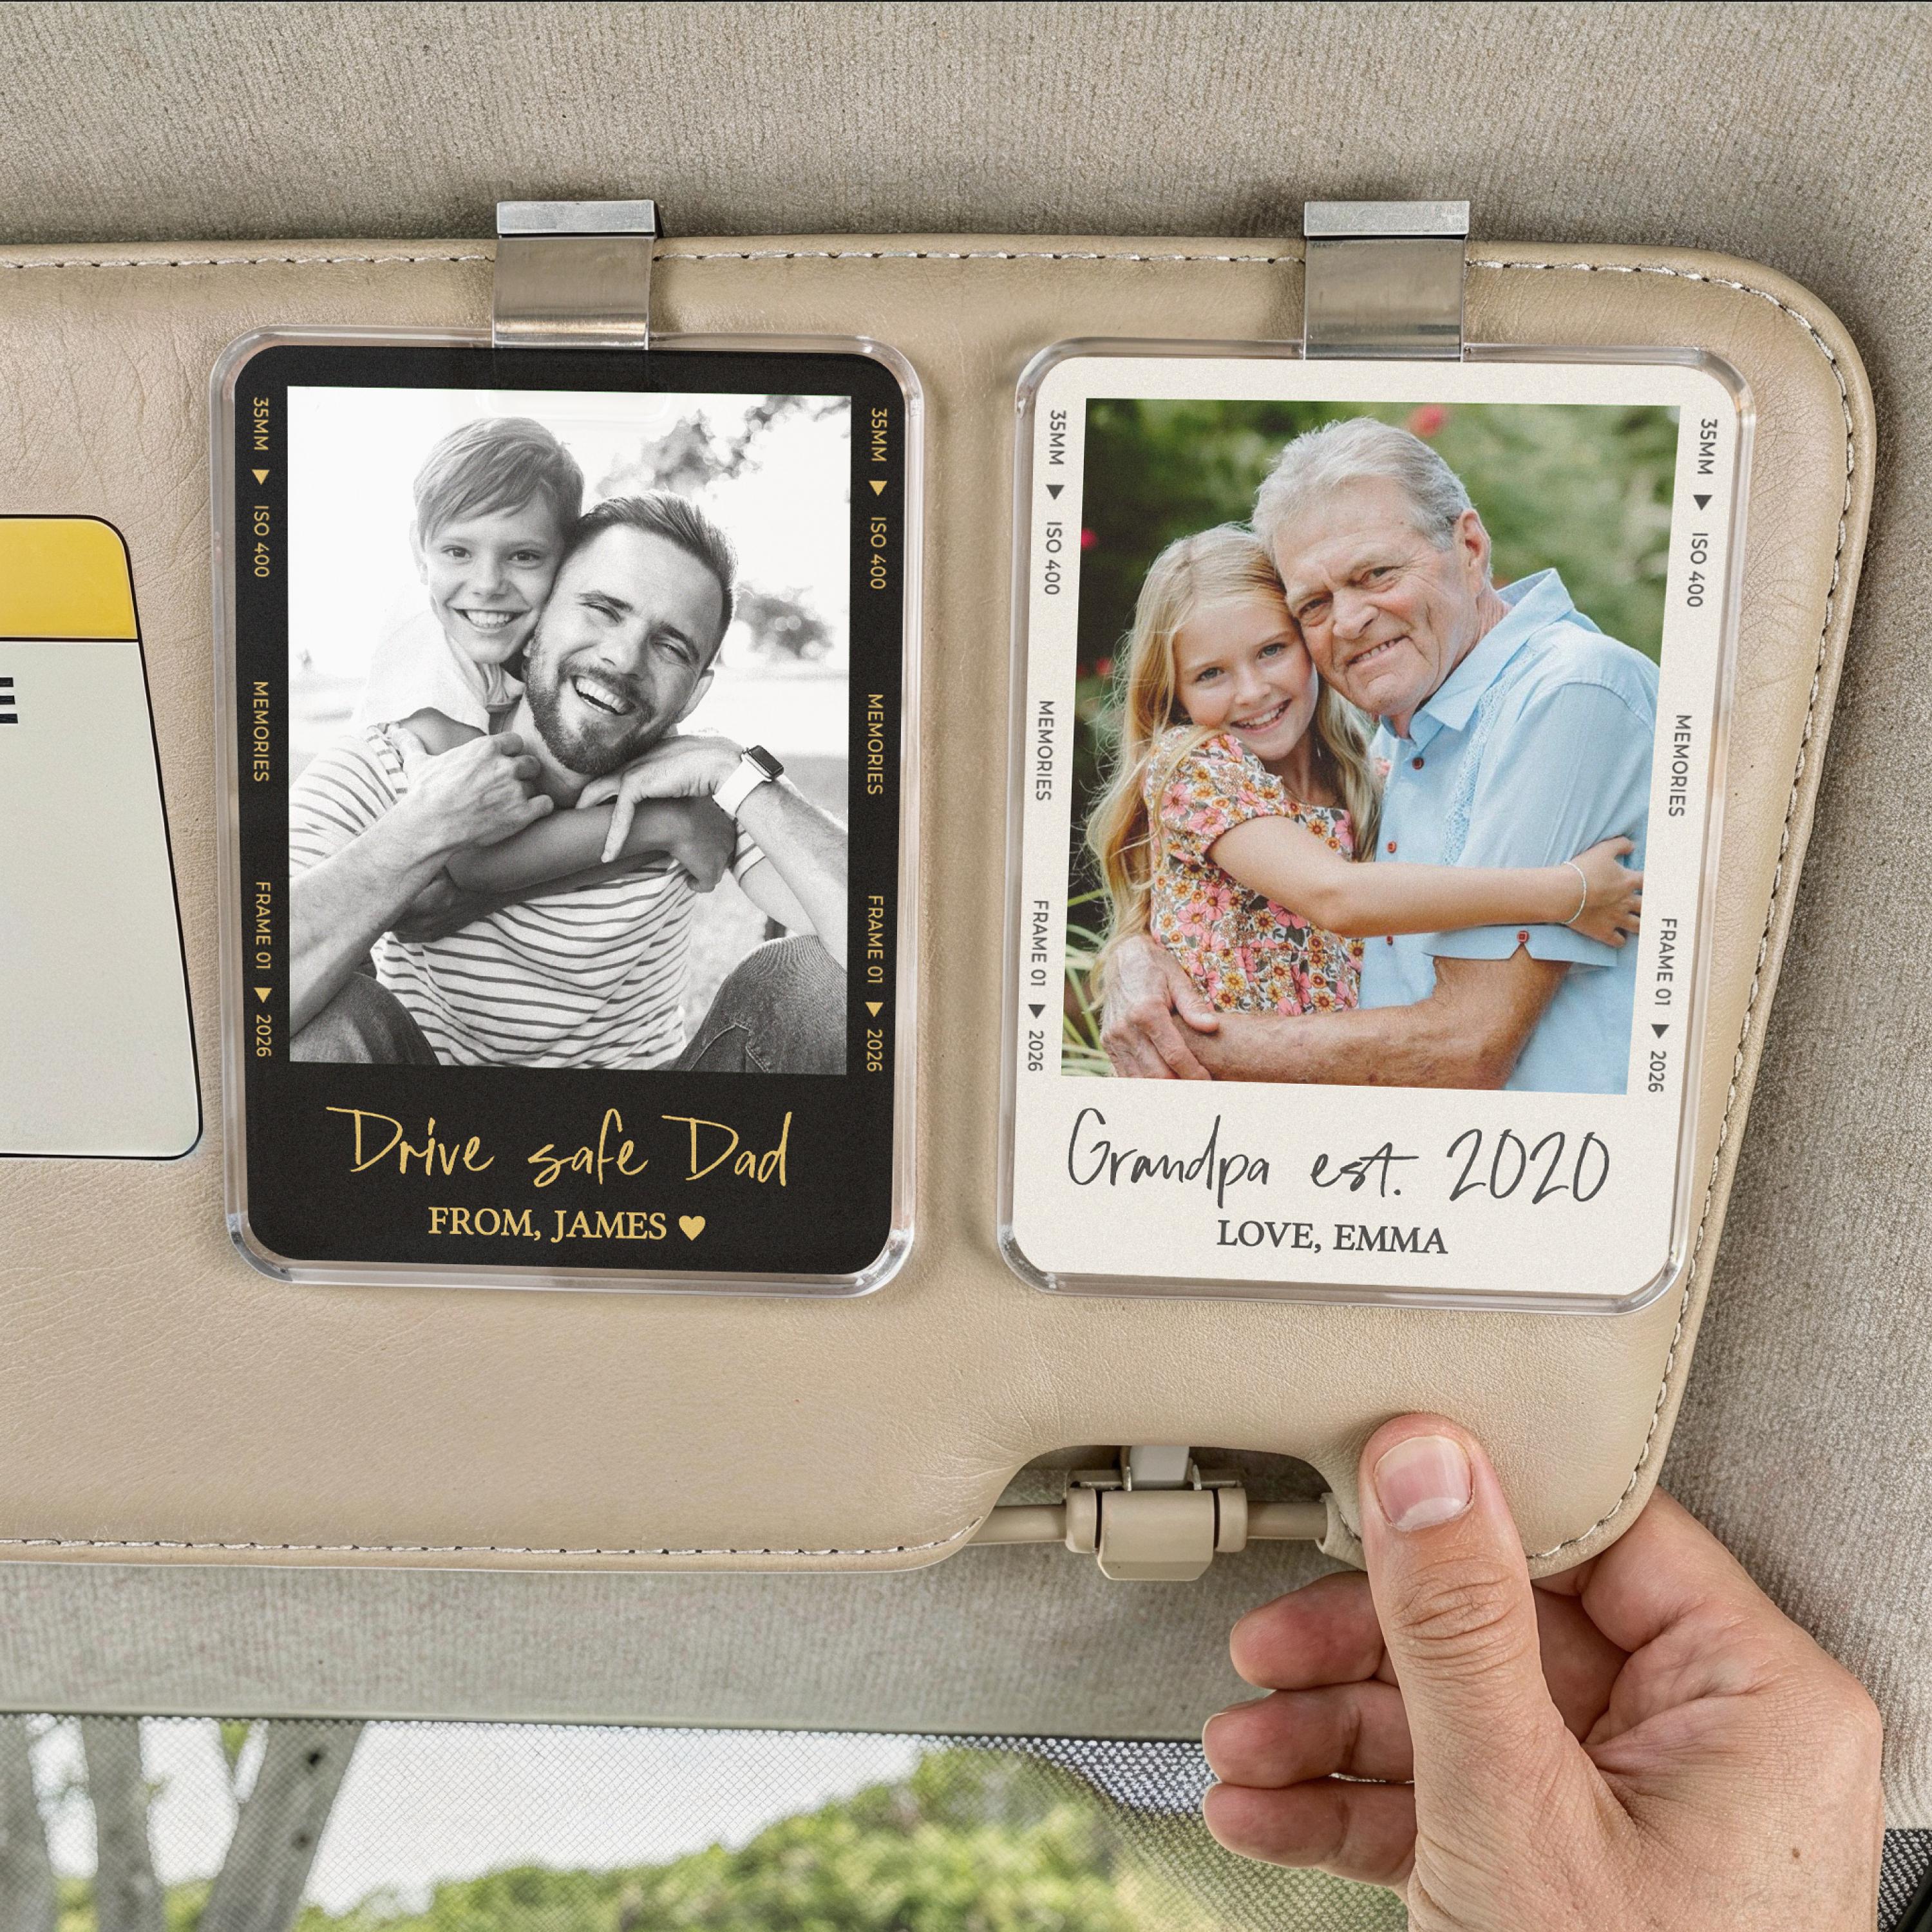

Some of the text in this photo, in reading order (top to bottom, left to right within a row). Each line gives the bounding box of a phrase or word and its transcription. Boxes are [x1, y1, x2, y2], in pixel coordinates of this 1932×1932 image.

[254, 398, 270, 578] 35MM ISO 400
[870, 408, 887, 589] 35MM ISO 400
[1045, 410, 1066, 595] 35MM ISO 400
[1687, 419, 1718, 607] 35MM ISO 400
[253, 681, 269, 782] MEMORIES
[867, 694, 884, 794] MEMORIES
[1036, 701, 1054, 800] MEMORIES
[1668, 715, 1692, 817] MEMORIES
[256, 882, 272, 1057] FRAME 01 2026
[866, 895, 884, 1072] FRAME 01 2026
[1028, 900, 1049, 1072] FRAME 01 2026
[1647, 918, 1677, 1092] FRAME 01 2026
[326, 1106, 792, 1188] Drive safe Dad
[1068, 1108, 1610, 1209] Grandpa est. 2020
[428, 1206, 667, 1243] FROM, JAMES
[1217, 1219, 1448, 1255] LOVE, EMMA
